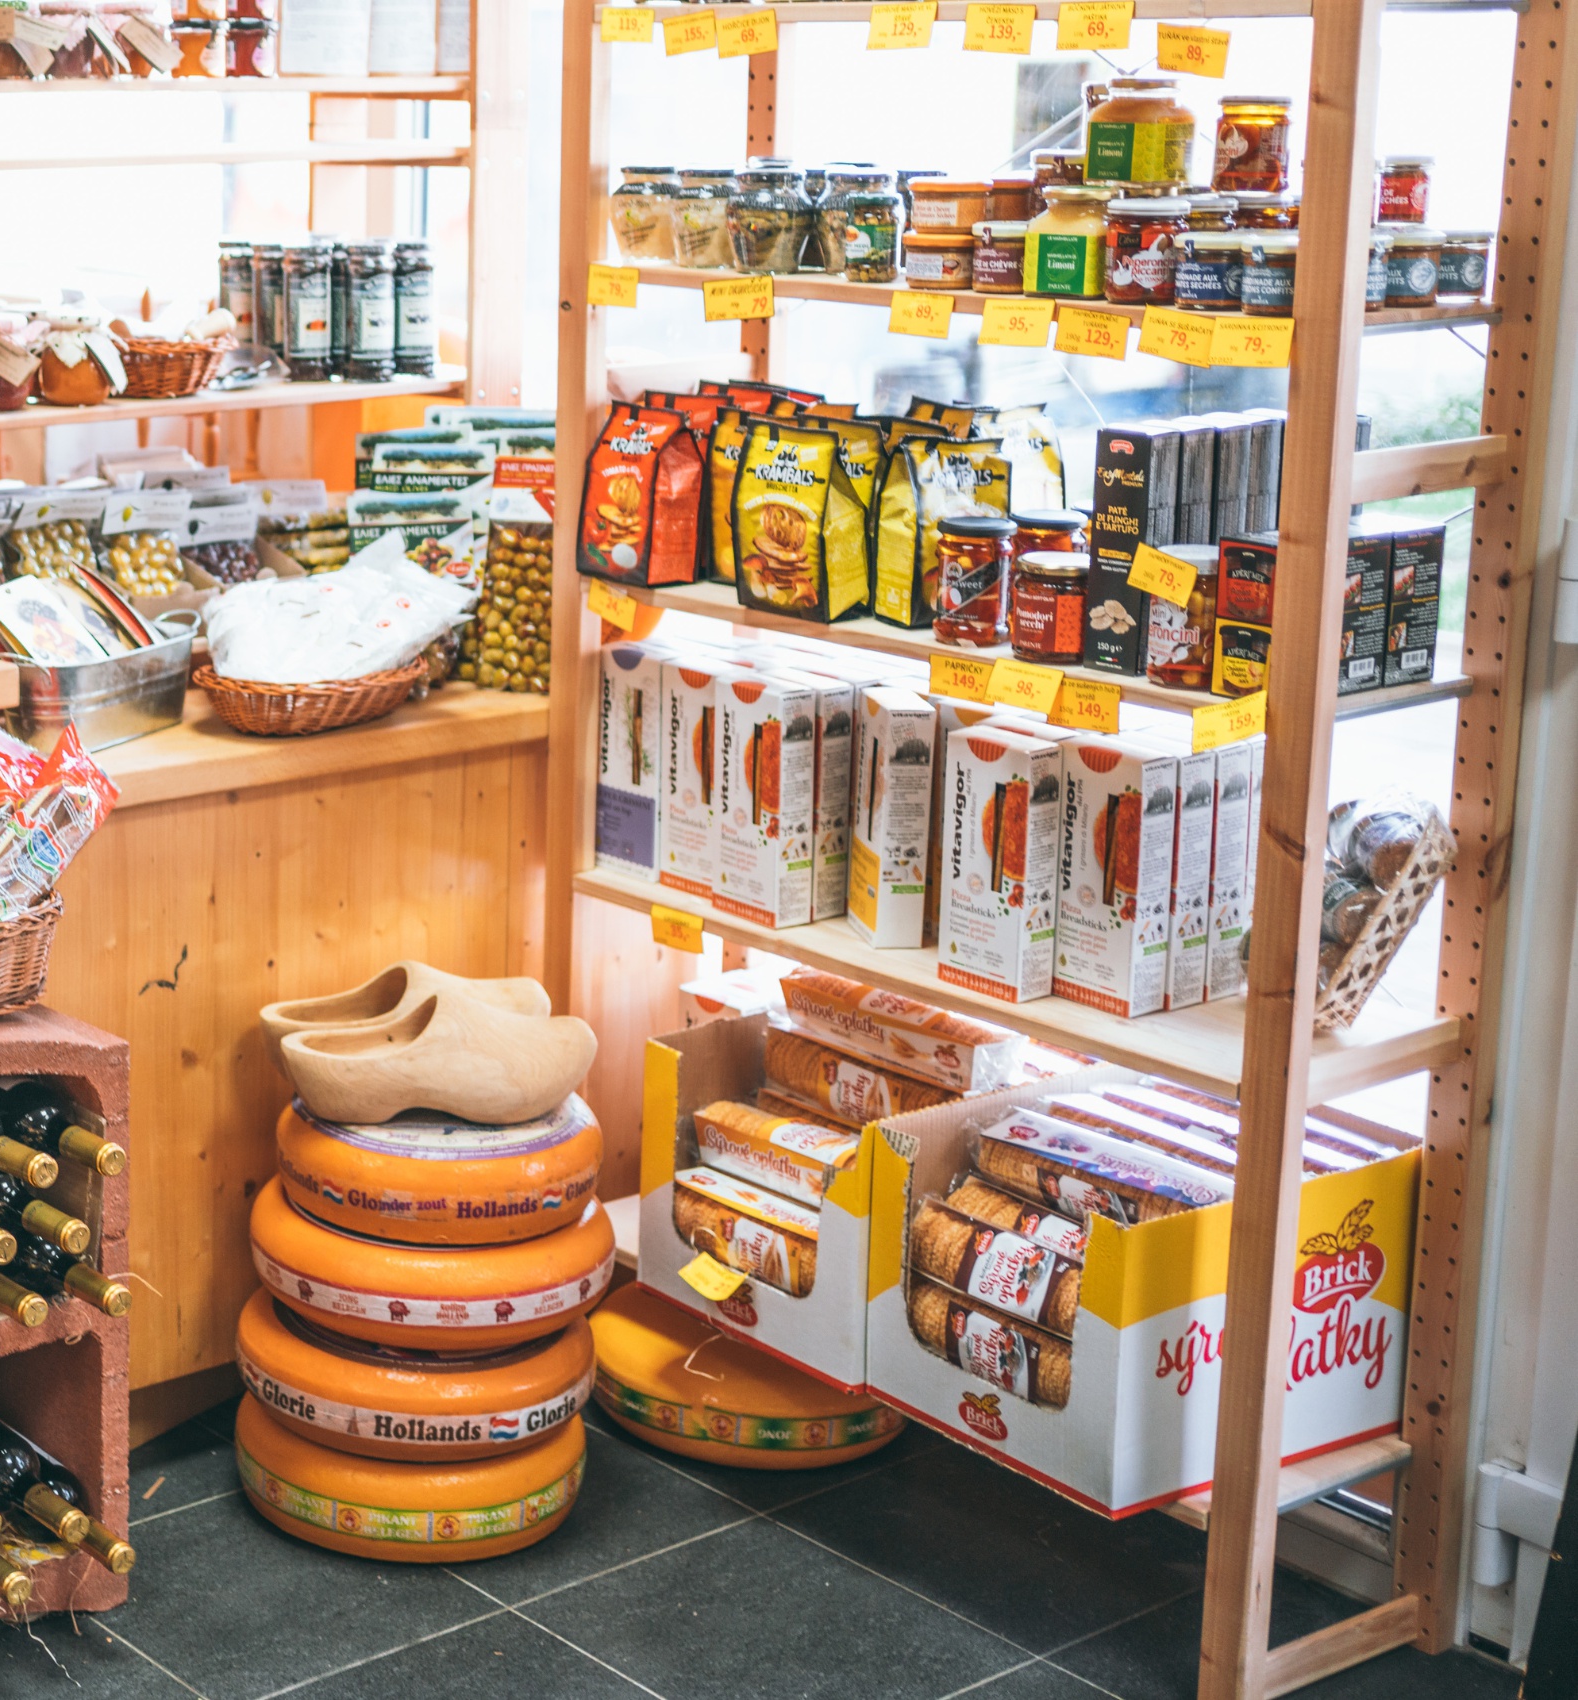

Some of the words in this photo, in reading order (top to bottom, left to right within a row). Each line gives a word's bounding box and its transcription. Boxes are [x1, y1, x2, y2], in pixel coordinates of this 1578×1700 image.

[618, 16, 644, 33] 119,-
[891, 22, 923, 37] 129,-
[988, 25, 1022, 42] 139,-
[1087, 21, 1114, 39] 69,-
[684, 27, 709, 42] 155,-
[740, 28, 762, 43] 69,-
[1186, 44, 1211, 65] 89,-
[1097, 147, 1124, 158] Limoni
[989, 258, 1018, 269] CHÈVRE
[1047, 259, 1076, 271] Limoni
[1202, 274, 1218, 283] AUX
[1274, 278, 1291, 287] AUX
[609, 282, 628, 299] 79,-
[915, 305, 939, 322] 89,-
[1008, 316, 1035, 333] 95,-
[1084, 328, 1121, 349] 129,-
[1170, 329, 1196, 351] 79,-
[1244, 336, 1272, 355] 79,-
[404, 474, 469, 487] ΑΝΑΜΕΙΚΤΕΣ
[754, 463, 815, 487] KRAMBALS
[1095, 520, 1101, 531] E
[1101, 522, 1140, 536] TARTUFO
[1096, 512, 1106, 522] DI
[1106, 514, 1139, 528] FUNGHI
[1159, 567, 1182, 592] 79,-
[1151, 608, 1167, 620] Mini
[1019, 618, 1045, 631] secchi
[1148, 625, 1200, 646] eroncini
[944, 659, 984, 675] PAPRIČKY
[952, 672, 984, 693] 149,-
[1015, 679, 1042, 699] 98,-
[1077, 700, 1110, 721] 149,-
[601, 670, 611, 775] vitavigor
[1228, 712, 1261, 732] 159,-
[670, 688, 683, 796] vitavigor
[721, 703, 734, 816] vitavigor
[952, 761, 969, 881] vitavigor
[1062, 771, 1078, 893] vitavigor
[951, 888, 972, 903] Pizza
[951, 898, 997, 920] Breadsticks
[1060, 909, 1108, 933] Breadsticks
[790, 987, 836, 1022] Sýrové
[837, 1007, 886, 1044] oplatky
[704, 1124, 750, 1158] Sýrové
[753, 1148, 802, 1184] oplatky
[280, 1153, 320, 1195] ollands
[455, 1197, 540, 1220] Hollands
[979, 1250, 1007, 1296] Sýrové
[998, 1244, 1036, 1304] oplatky
[1303, 1250, 1373, 1300] Brick
[331, 1301, 367, 1316] BELEGEN
[337, 1292, 360, 1306] JONG
[533, 1300, 565, 1316] BELEGEN
[540, 1292, 561, 1306] JONG
[1155, 1319, 1225, 1396] sýr
[262, 1378, 317, 1422] Glorie
[526, 1394, 577, 1433] Glorie
[965, 1406, 1002, 1436] Brick
[373, 1414, 482, 1442] Hollands
[758, 1428, 794, 1441] JONG
[284, 1486, 326, 1511] PIKANT
[367, 1512, 417, 1526] PIKANT
[467, 1509, 512, 1524] PIKANT
[363, 1524, 422, 1540] BELEGEN
[463, 1520, 517, 1537] BELEGEN
